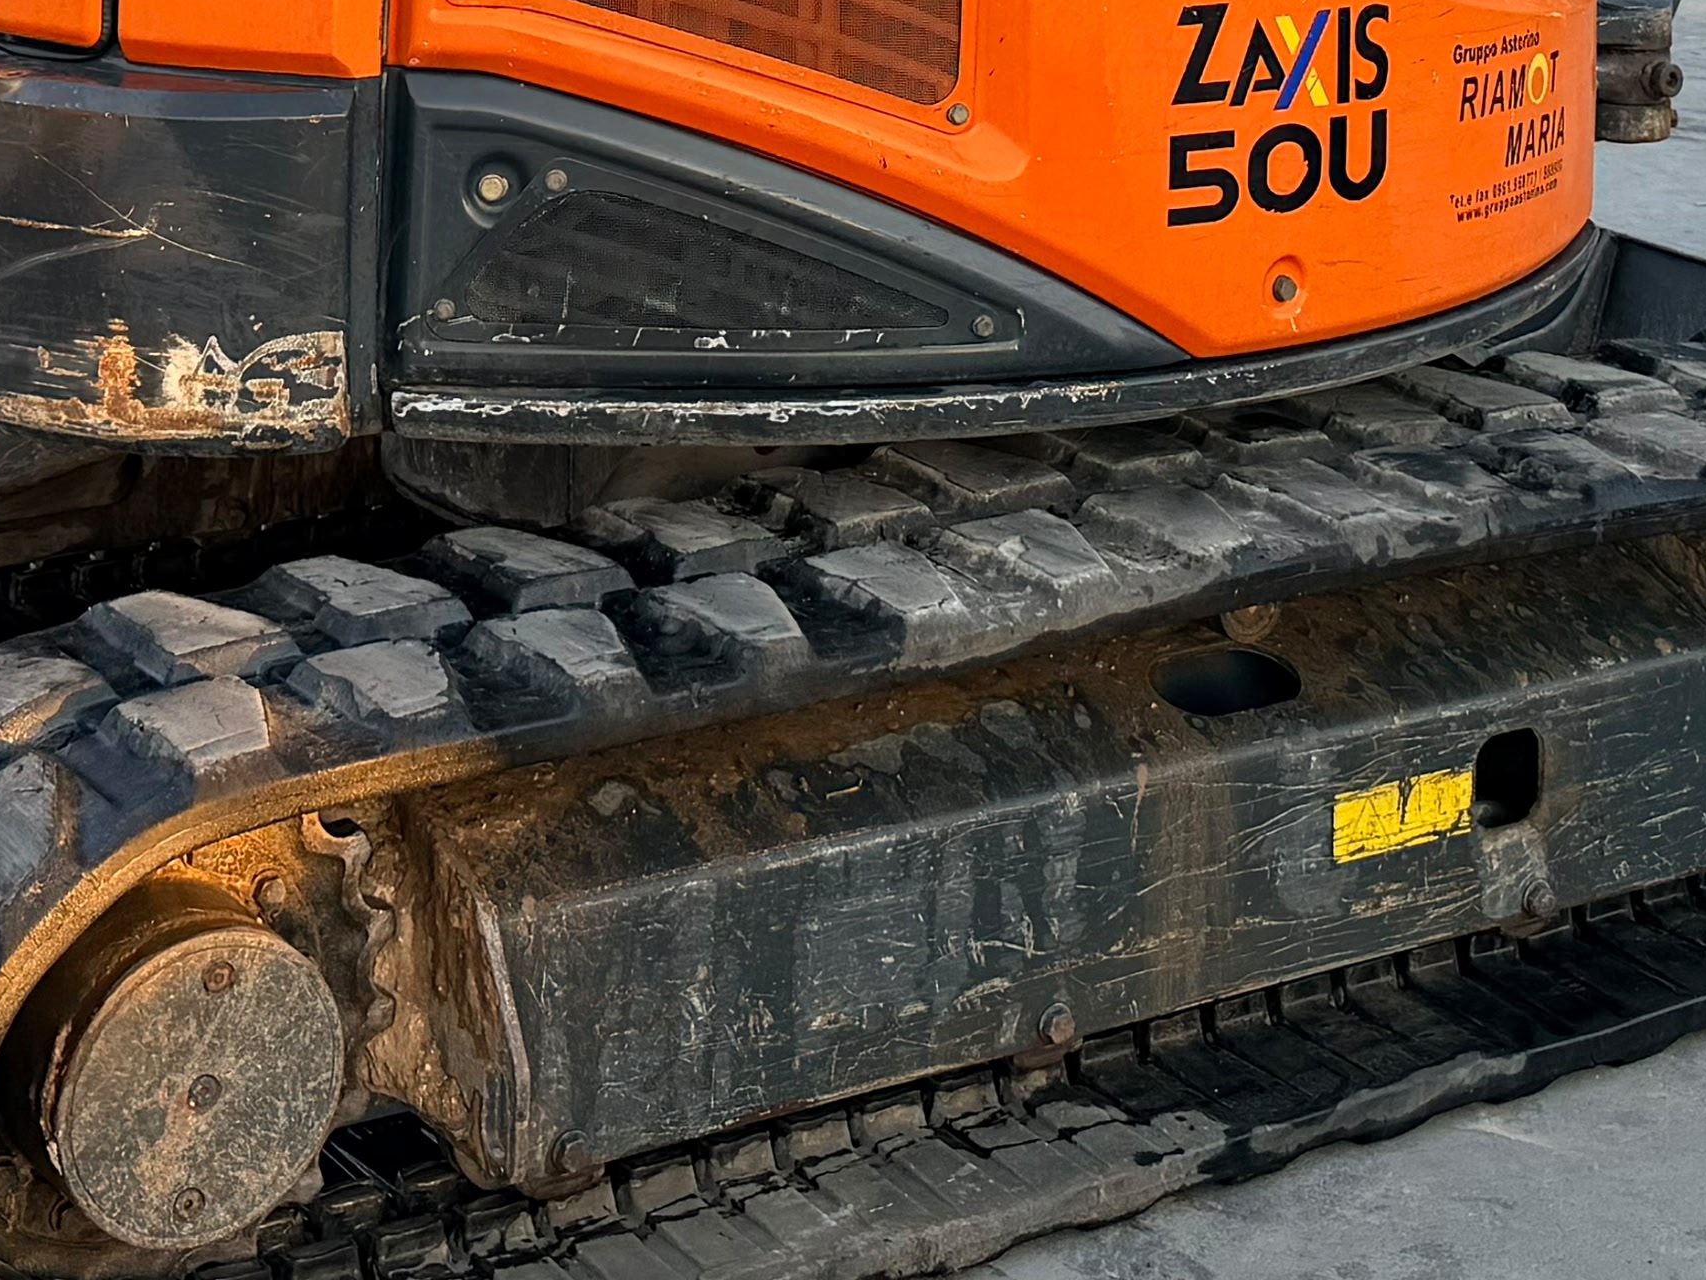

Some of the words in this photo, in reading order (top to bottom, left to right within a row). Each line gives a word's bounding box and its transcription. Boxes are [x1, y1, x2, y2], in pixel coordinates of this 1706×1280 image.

[1170, 2, 1390, 110] ZAXIS
[1453, 43, 1498, 66] Gruppo
[1459, 49, 1560, 123] RIAMOT
[1166, 108, 1388, 227] 50U
[1504, 106, 1565, 168] MARIA
